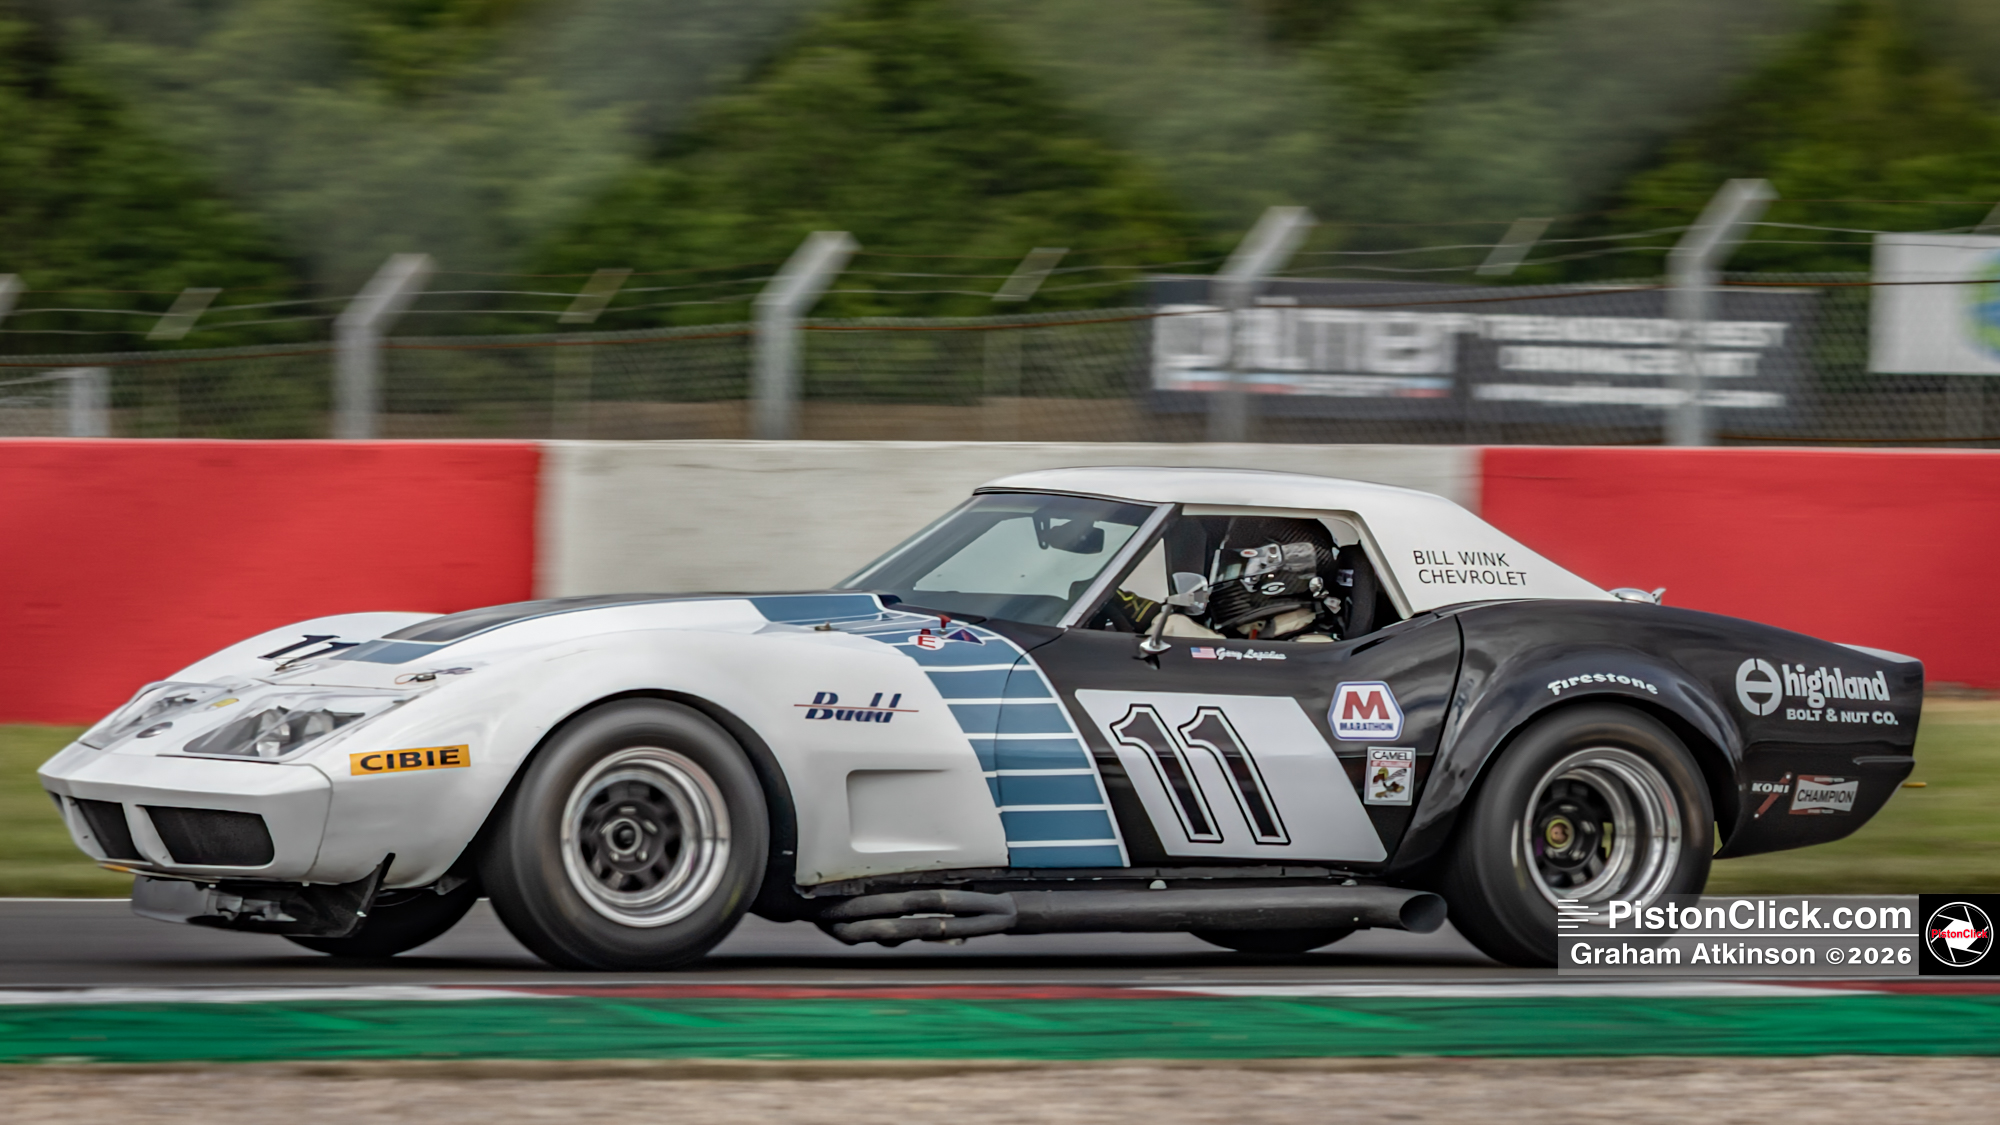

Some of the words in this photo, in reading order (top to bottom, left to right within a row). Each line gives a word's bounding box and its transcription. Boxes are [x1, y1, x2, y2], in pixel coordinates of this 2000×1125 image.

[1413, 550, 1455, 565] BILL
[1457, 551, 1510, 567] WINK
[1418, 569, 1527, 585] CHEVROLET
[917, 635, 937, 649] E
[1547, 672, 1659, 696] Firestone
[1781, 663, 1891, 709] highland
[804, 691, 902, 724] Budd
[1342, 691, 1391, 720] M
[1785, 708, 1823, 722] BOLT
[1825, 708, 1838, 722] &
[1840, 710, 1870, 724] NUT
[1871, 710, 1899, 726] CO.
[1339, 722, 1394, 732] MARATHON
[1372, 751, 1410, 761] CAMEL
[1109, 703, 1291, 845] 11
[1751, 782, 1790, 794] KONI
[1797, 789, 1855, 804] CHAMPION
